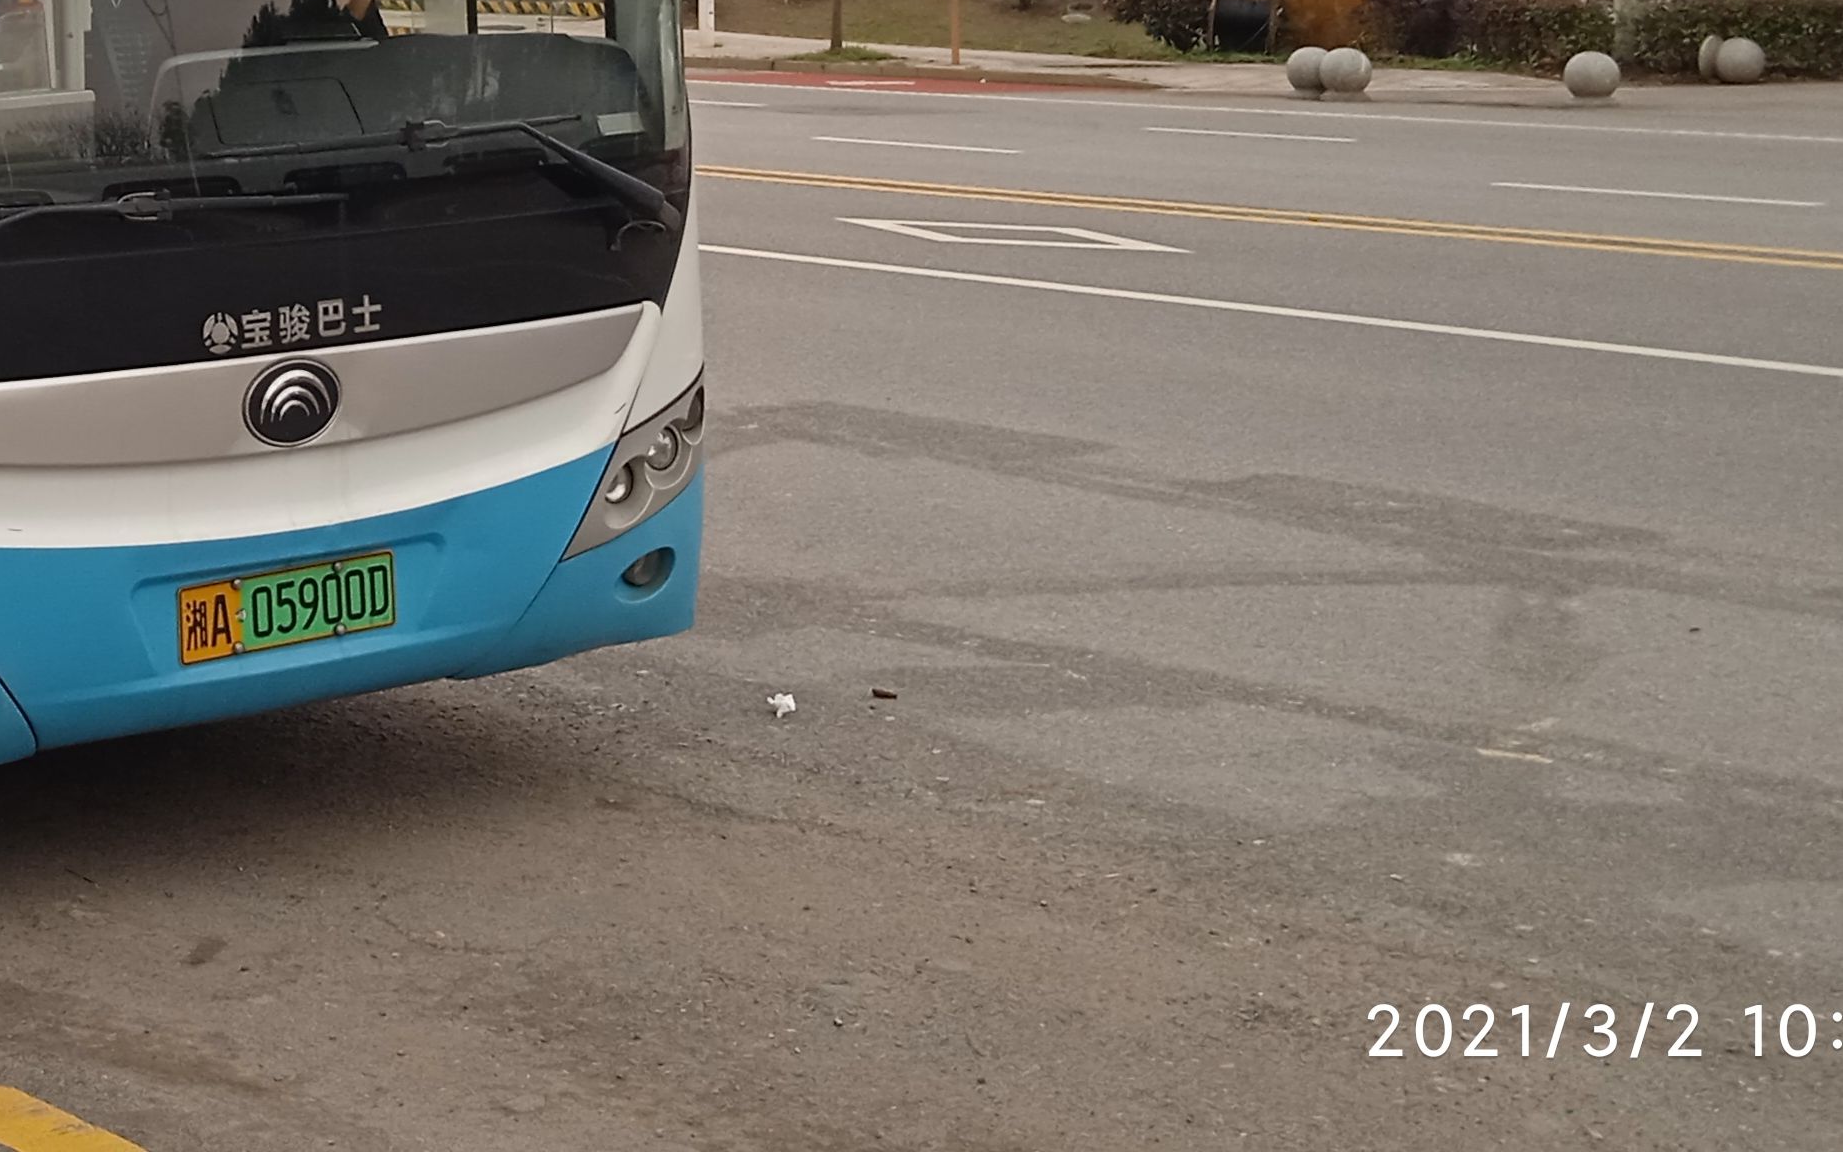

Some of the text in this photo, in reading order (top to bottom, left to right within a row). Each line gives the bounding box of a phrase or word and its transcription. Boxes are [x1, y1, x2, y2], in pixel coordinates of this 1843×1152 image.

[241, 295, 383, 348] 宝骏巴士
[251, 563, 390, 638] 05900D
